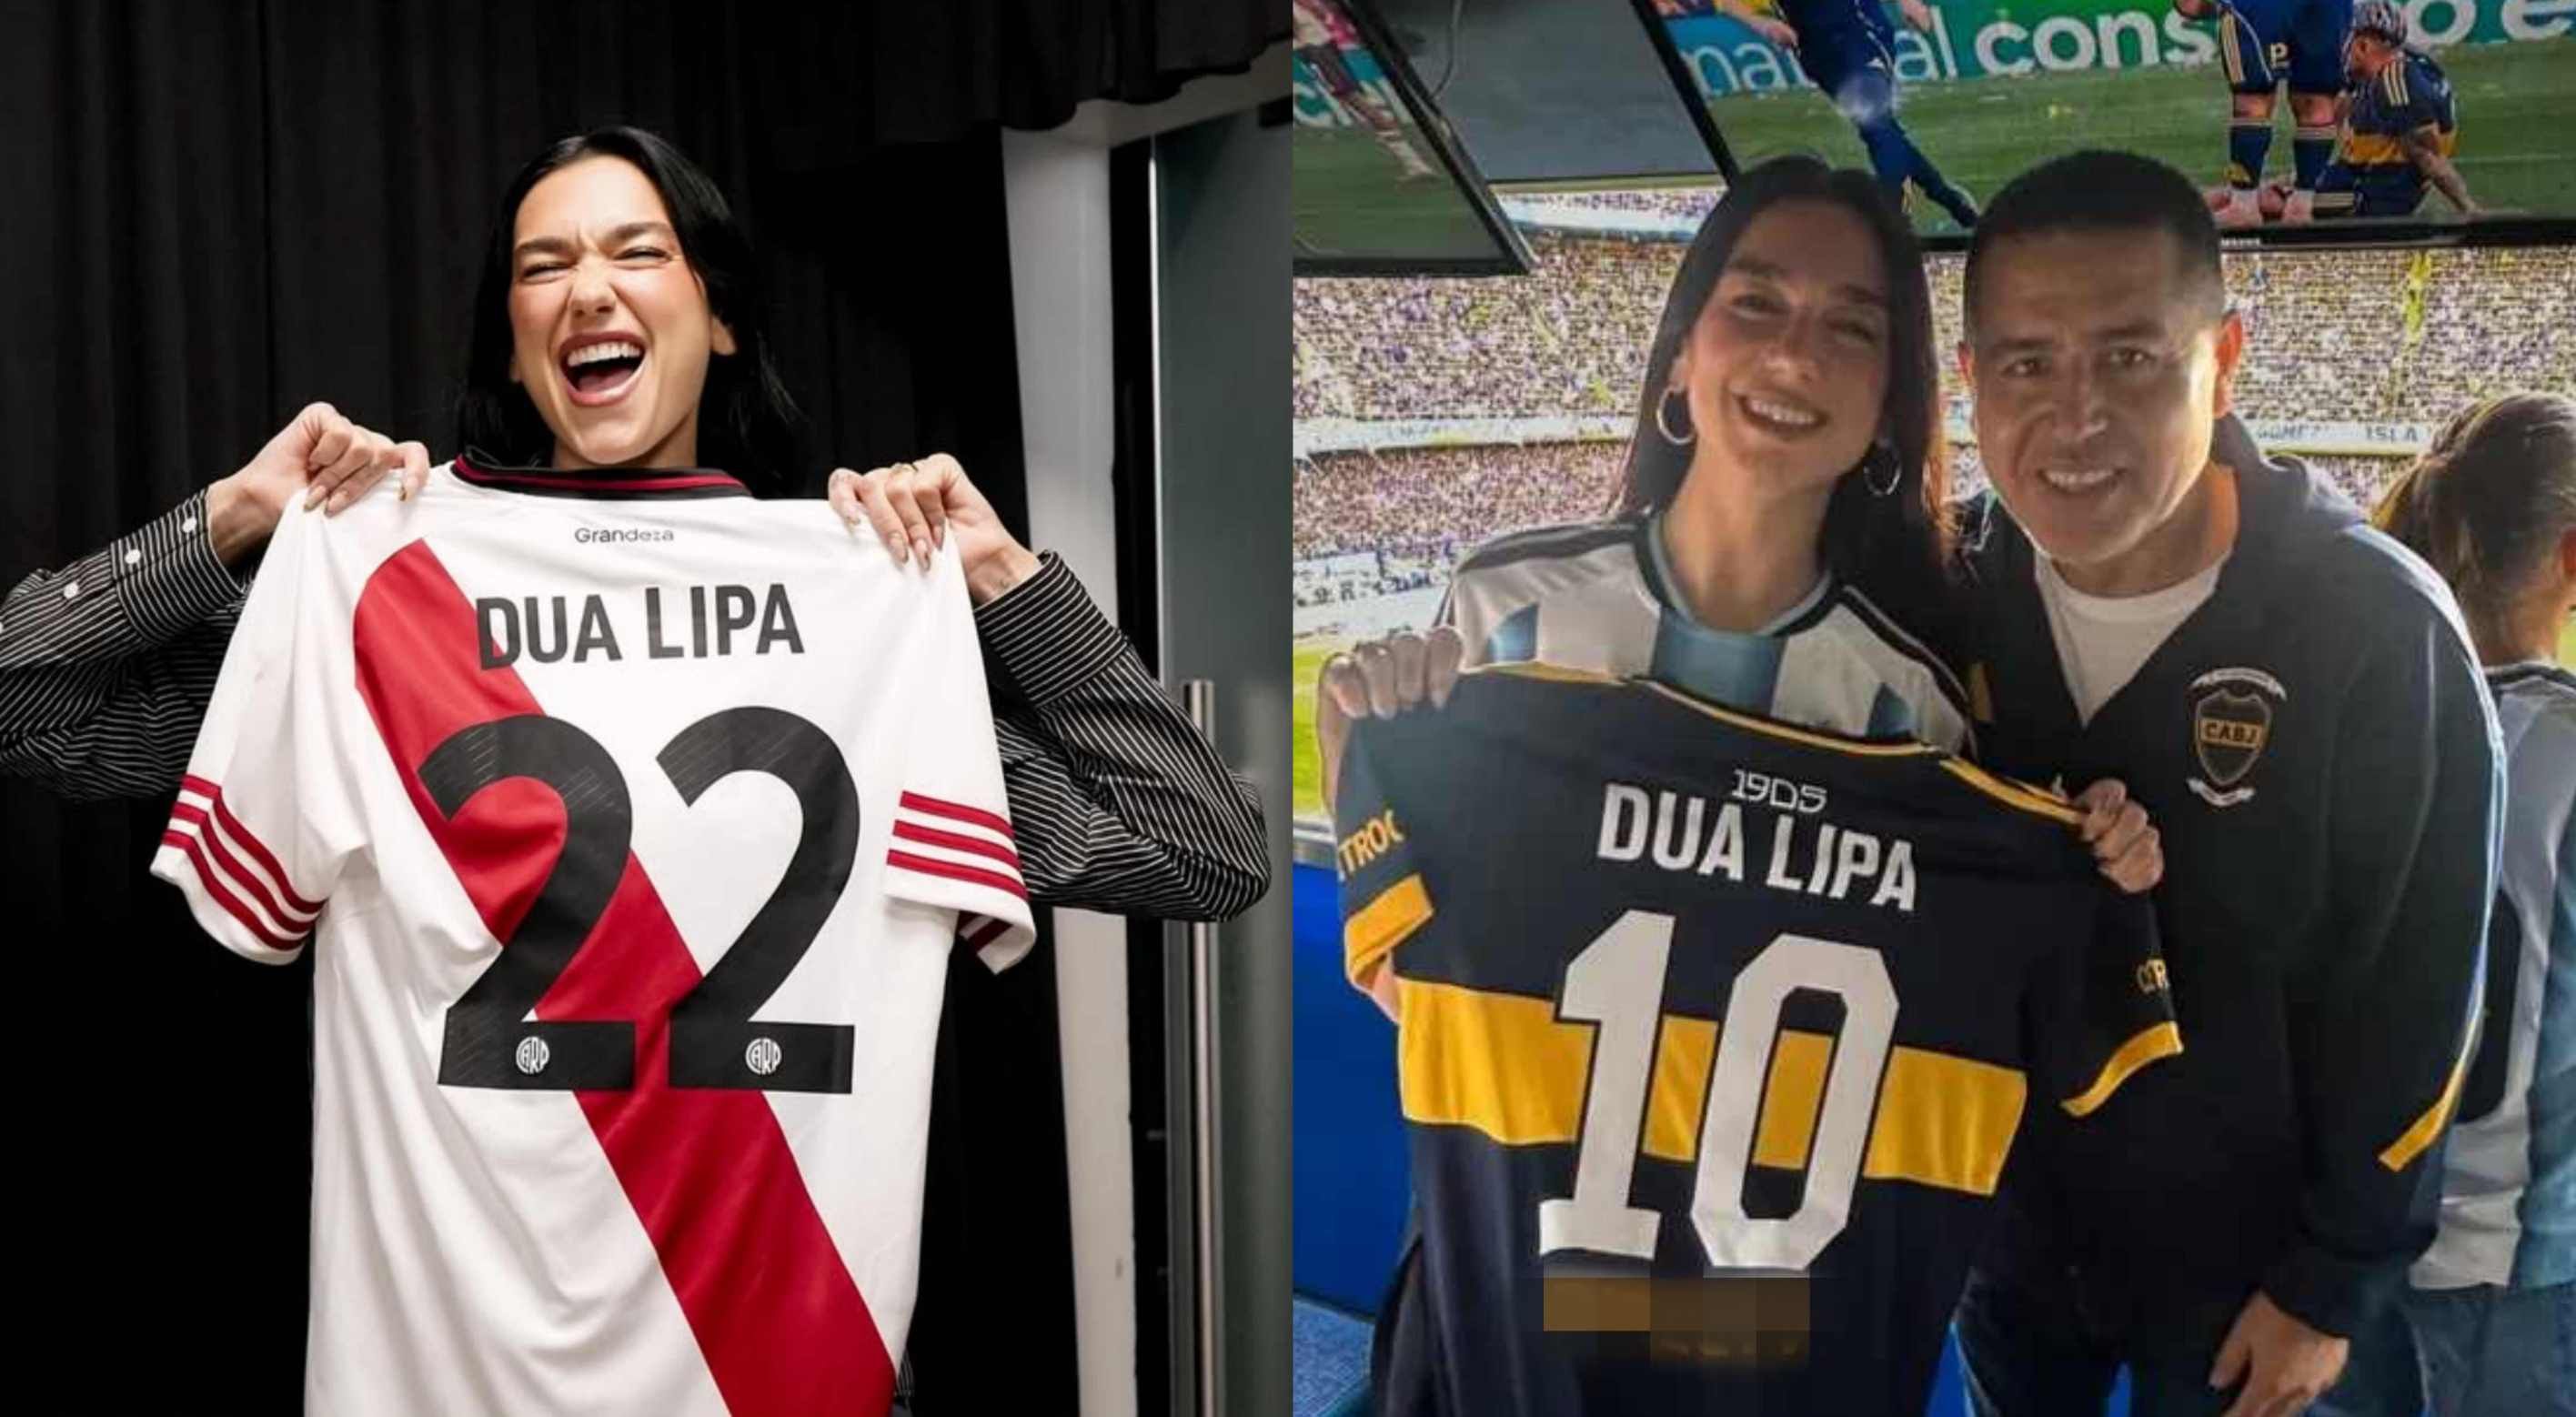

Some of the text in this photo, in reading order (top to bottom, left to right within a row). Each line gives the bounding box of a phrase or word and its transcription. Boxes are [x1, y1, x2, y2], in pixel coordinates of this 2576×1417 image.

[574, 527, 675, 544] Grandeza
[476, 583, 805, 670] DUA LIPA
[2206, 722, 2259, 743] CABJ
[417, 705, 860, 1094] 22
[1596, 782, 1917, 912] DUA LIPA
[1539, 909, 1900, 1271] 10
